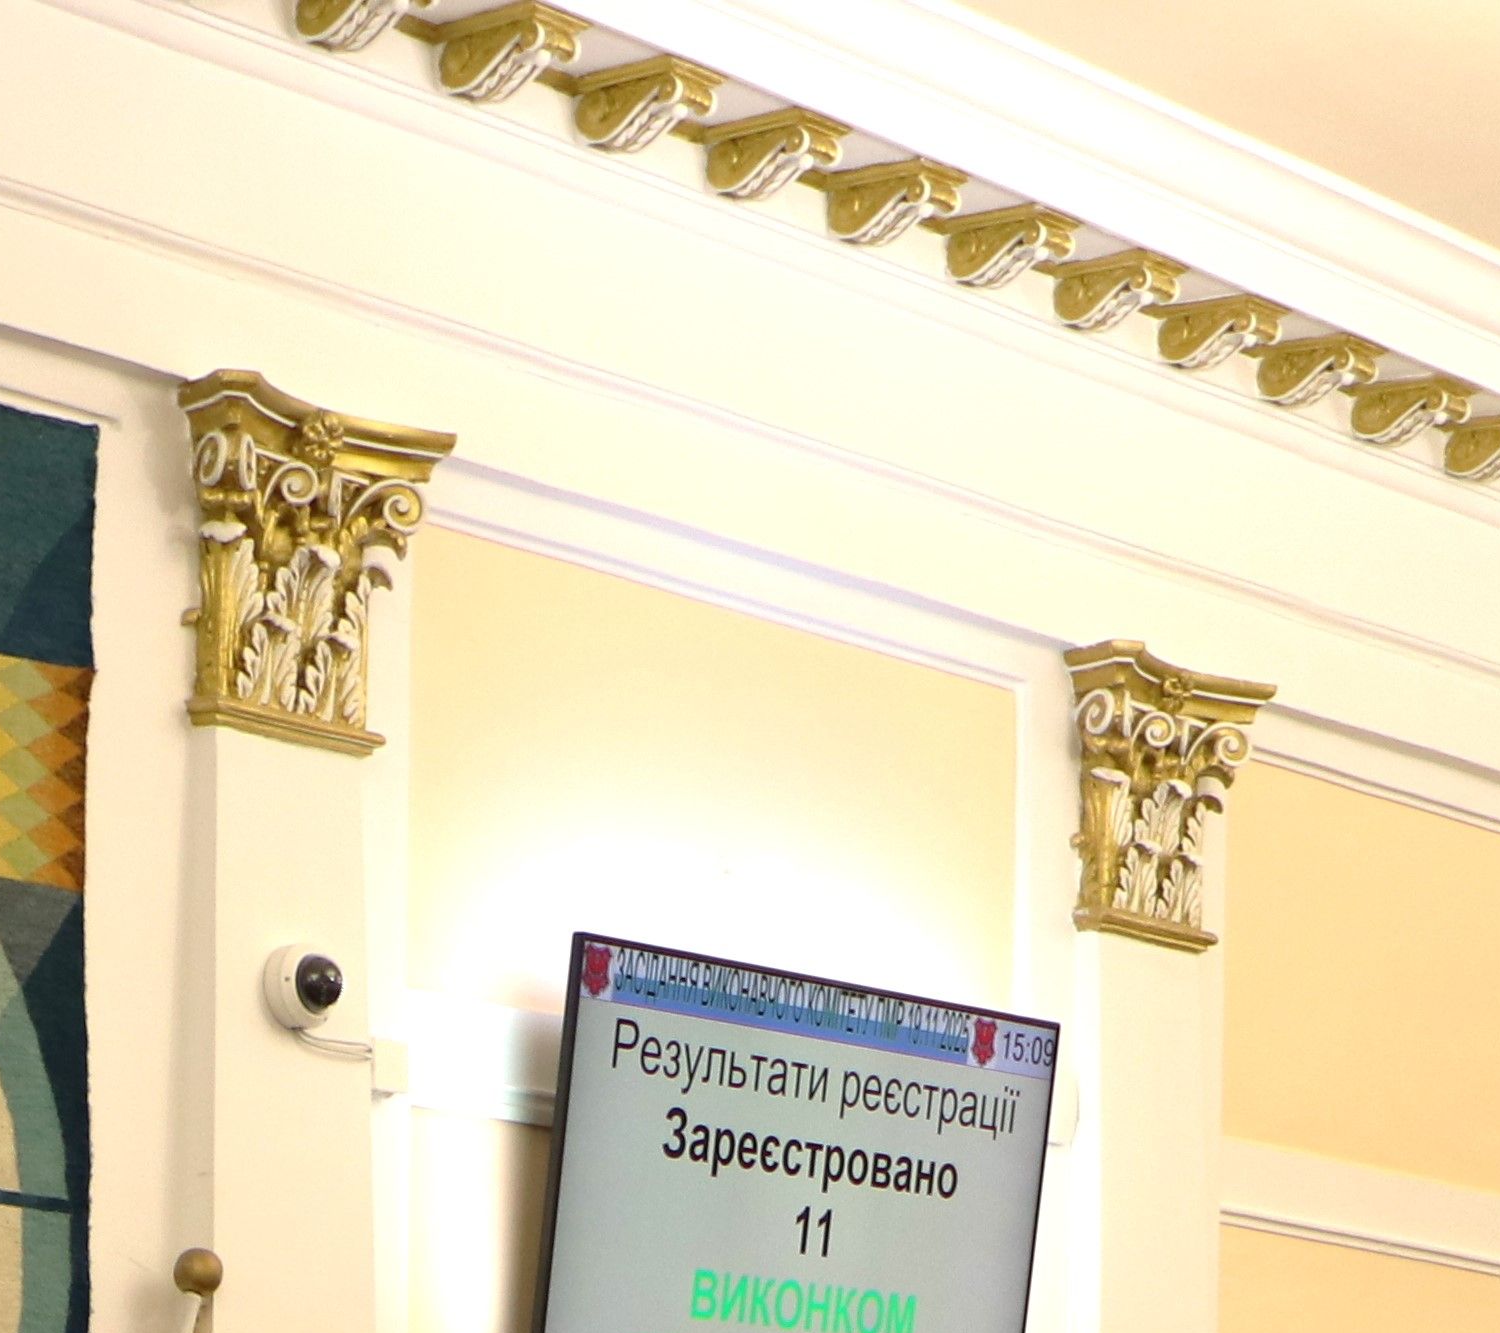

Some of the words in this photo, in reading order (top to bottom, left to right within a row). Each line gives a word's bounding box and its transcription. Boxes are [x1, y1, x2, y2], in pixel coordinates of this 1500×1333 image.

[615, 947, 701, 1005] ЗАСІДАННЯ
[1002, 1031, 1054, 1067] 15:09
[611, 1017, 829, 1104] Результати
[839, 1070, 1021, 1141] реєстрації
[661, 1106, 958, 1200] Зареєстровано
[795, 1205, 833, 1258] 11
